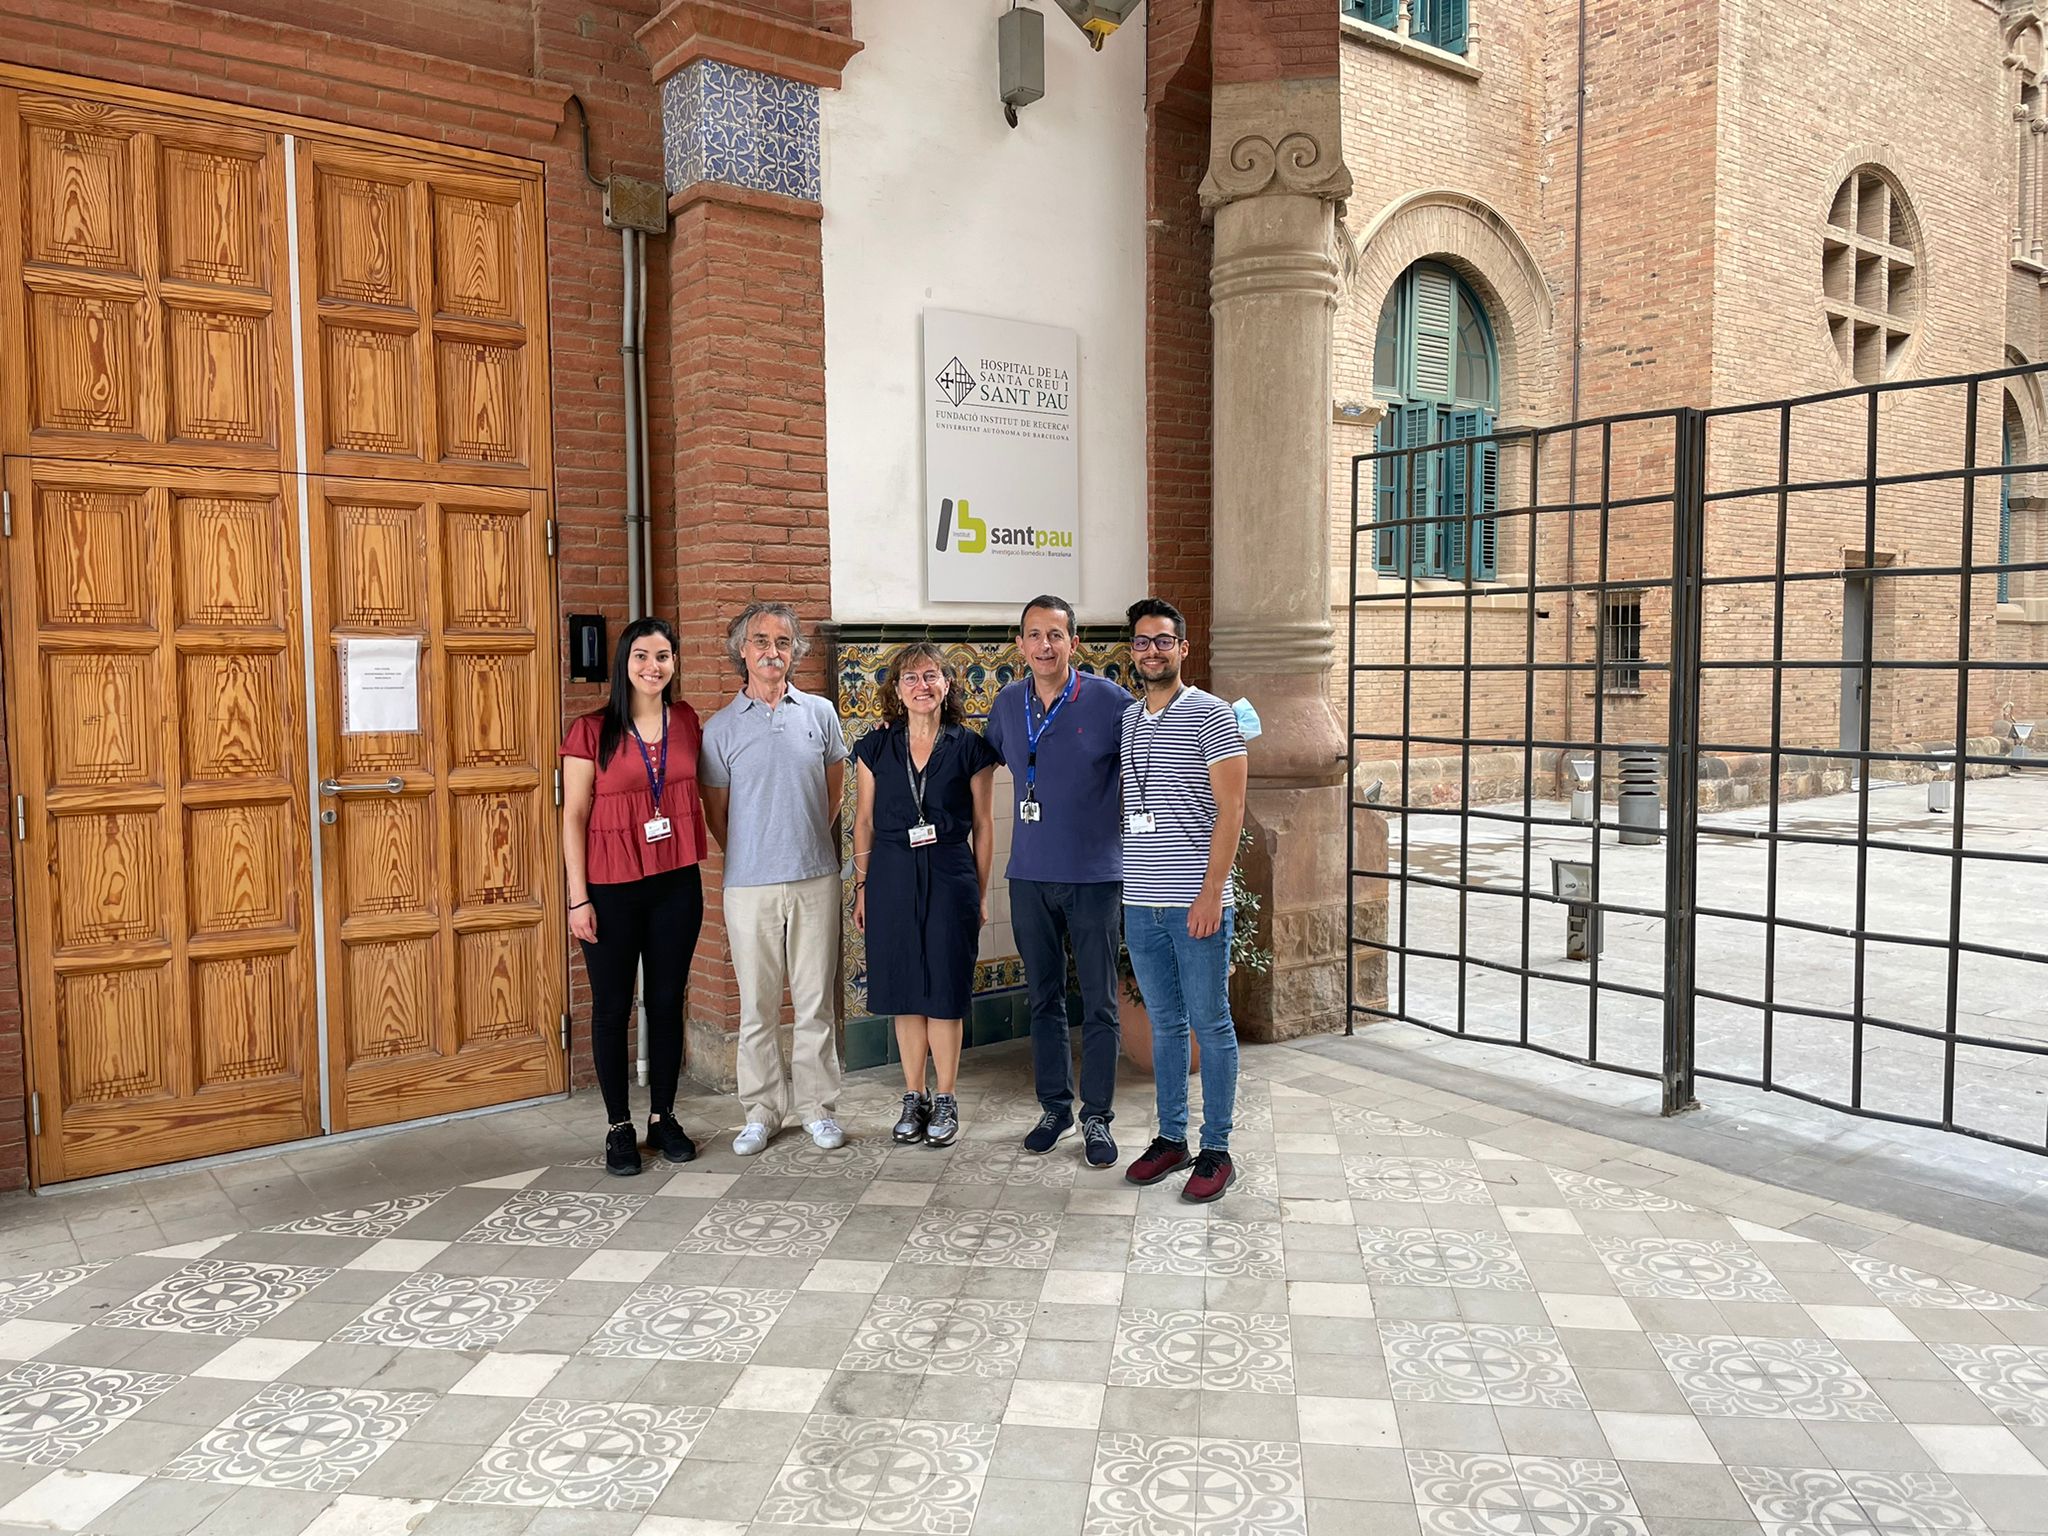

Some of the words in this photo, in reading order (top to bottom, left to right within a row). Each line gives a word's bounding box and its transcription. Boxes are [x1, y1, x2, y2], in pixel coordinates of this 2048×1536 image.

[980, 359, 1034, 375] HOSPITAL
[1038, 366, 1051, 377] DE
[1055, 369, 1068, 380] LA
[980, 371, 1022, 386] SANTA
[1028, 378, 1059, 390] CREU
[980, 385, 1030, 405] SANT
[1036, 391, 1068, 410] PAU
[936, 410, 978, 422] FUNDACIÓ
[980, 415, 1018, 426] INSTITUT
[1020, 419, 1031, 428] DE
[936, 422, 980, 432] UNIVERSITAT
[1033, 432, 1069, 441] BARCELONA
